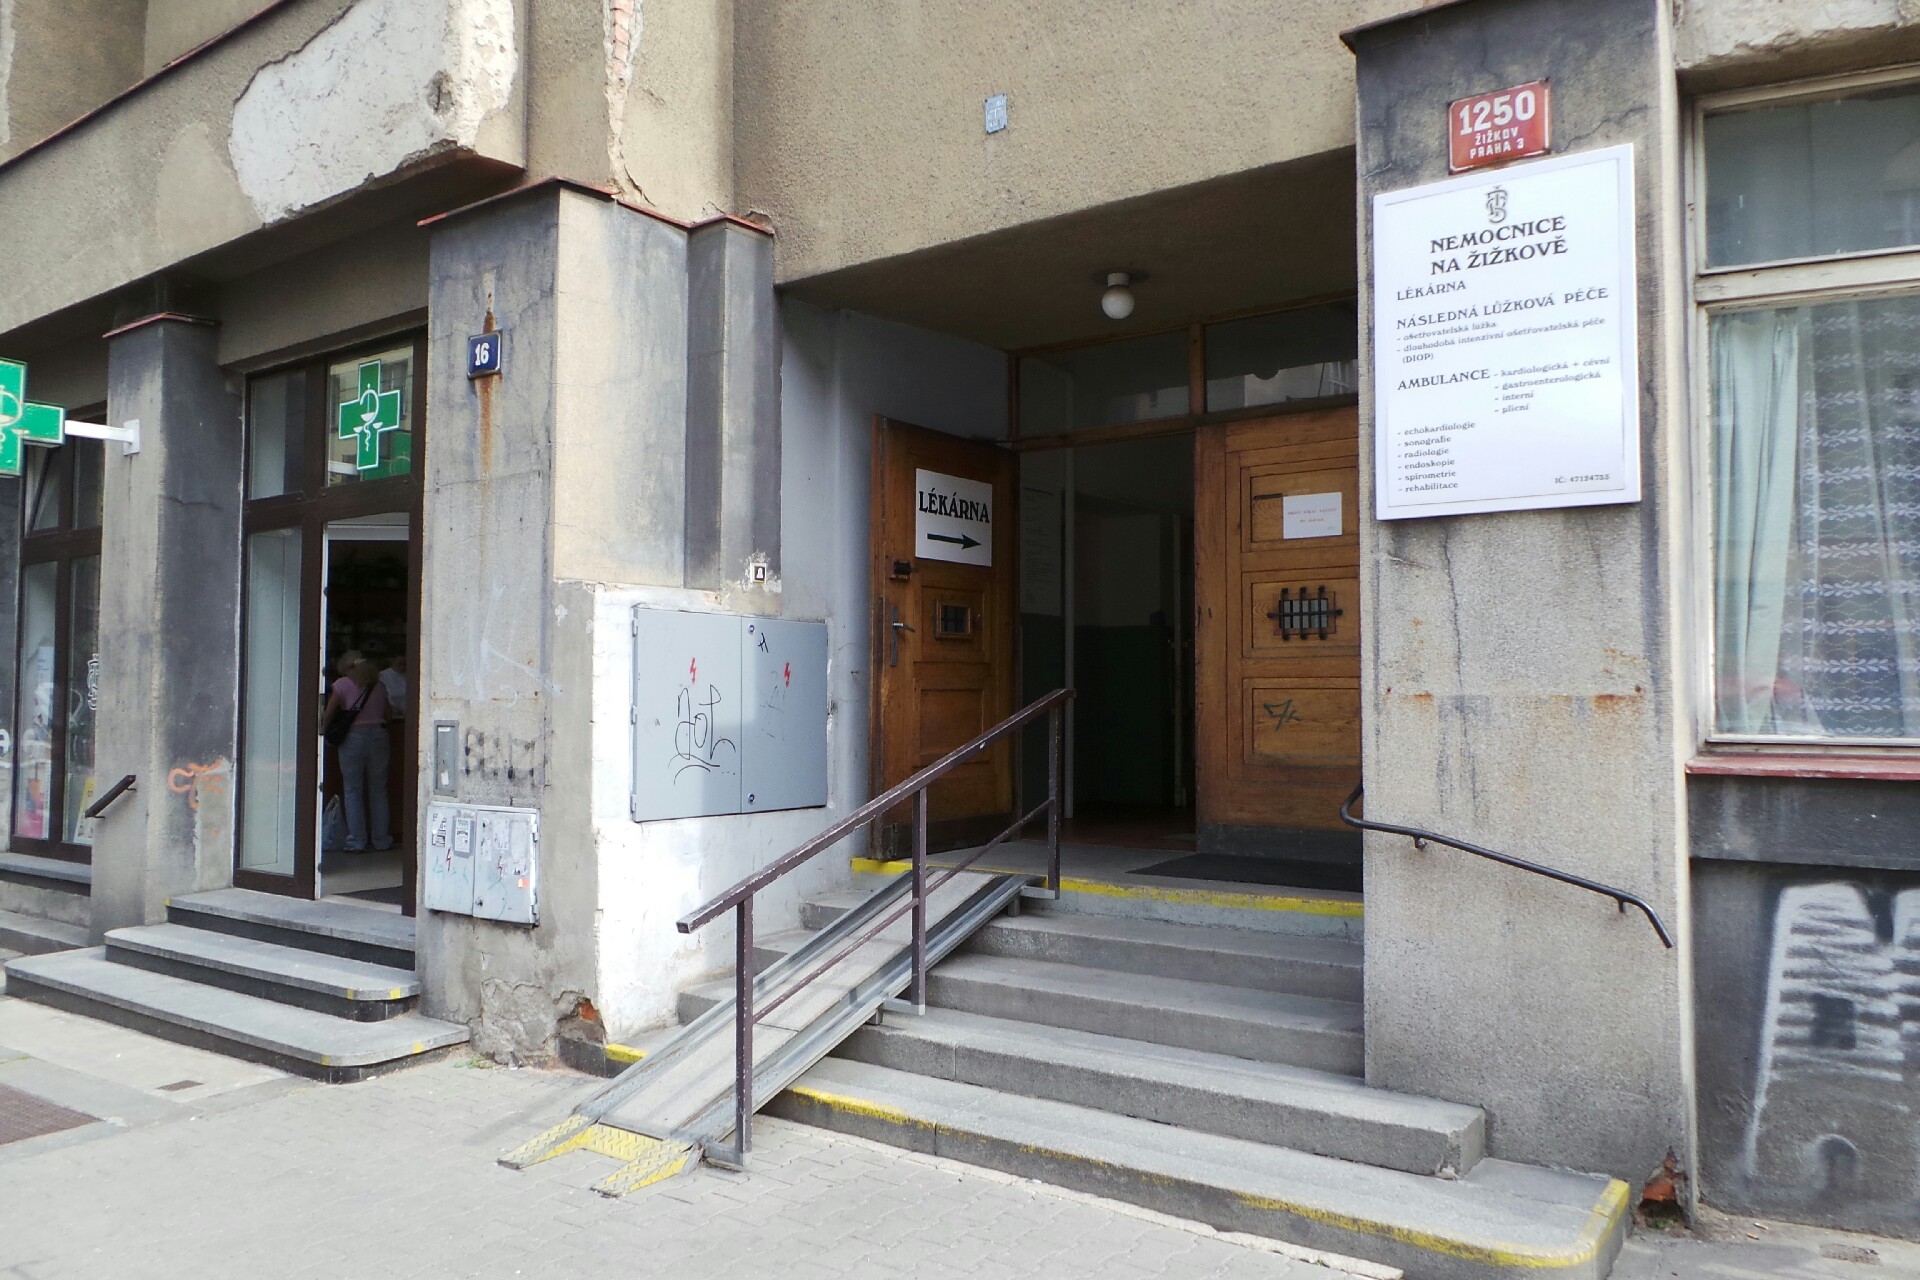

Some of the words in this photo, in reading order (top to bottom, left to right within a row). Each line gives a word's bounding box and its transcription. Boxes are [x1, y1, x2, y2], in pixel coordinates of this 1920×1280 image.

[1459, 89, 1536, 136] 1250
[1474, 126, 1519, 146] ŽIŽKOV
[1469, 141, 1511, 159] PRAHA
[1516, 137, 1524, 149] 3
[1430, 215, 1566, 254] NEMOCNICE
[1431, 258, 1461, 275] NA
[1467, 235, 1568, 269] ŽIŽKOVĚ
[1397, 280, 1466, 301] LÉKÁRNA
[1396, 304, 1478, 330] NÁSLEDNÁ
[1483, 292, 1555, 316] LŮŽKOVÁ
[1564, 286, 1609, 304] PÉČE
[1403, 323, 1469, 341] ošetřovatelská
[1403, 339, 1455, 352] dlouhodobá
[1458, 330, 1504, 344] intenzivní
[1506, 319, 1579, 337] ošetřovatelská
[1582, 316, 1606, 328] péče
[475, 342, 490, 366] 16
[1402, 352, 1434, 364] (DIOP)
[1397, 368, 1491, 391] AMBULANCE
[1501, 361, 1569, 377] kardiologická
[1583, 355, 1610, 366] cévní
[1502, 371, 1601, 390] gastroenterologická
[1502, 390, 1534, 401] interní
[1502, 403, 1529, 414] plicní
[1404, 421, 1476, 436] echokardiologie
[1404, 435, 1451, 447] sonografie
[1404, 447, 1449, 459] radiologie
[1404, 458, 1455, 470] endoskopie
[1404, 470, 1456, 482] spirometrie
[1405, 482, 1459, 492] rehabilitace
[918, 487, 990, 524] LÉKÁRNA
